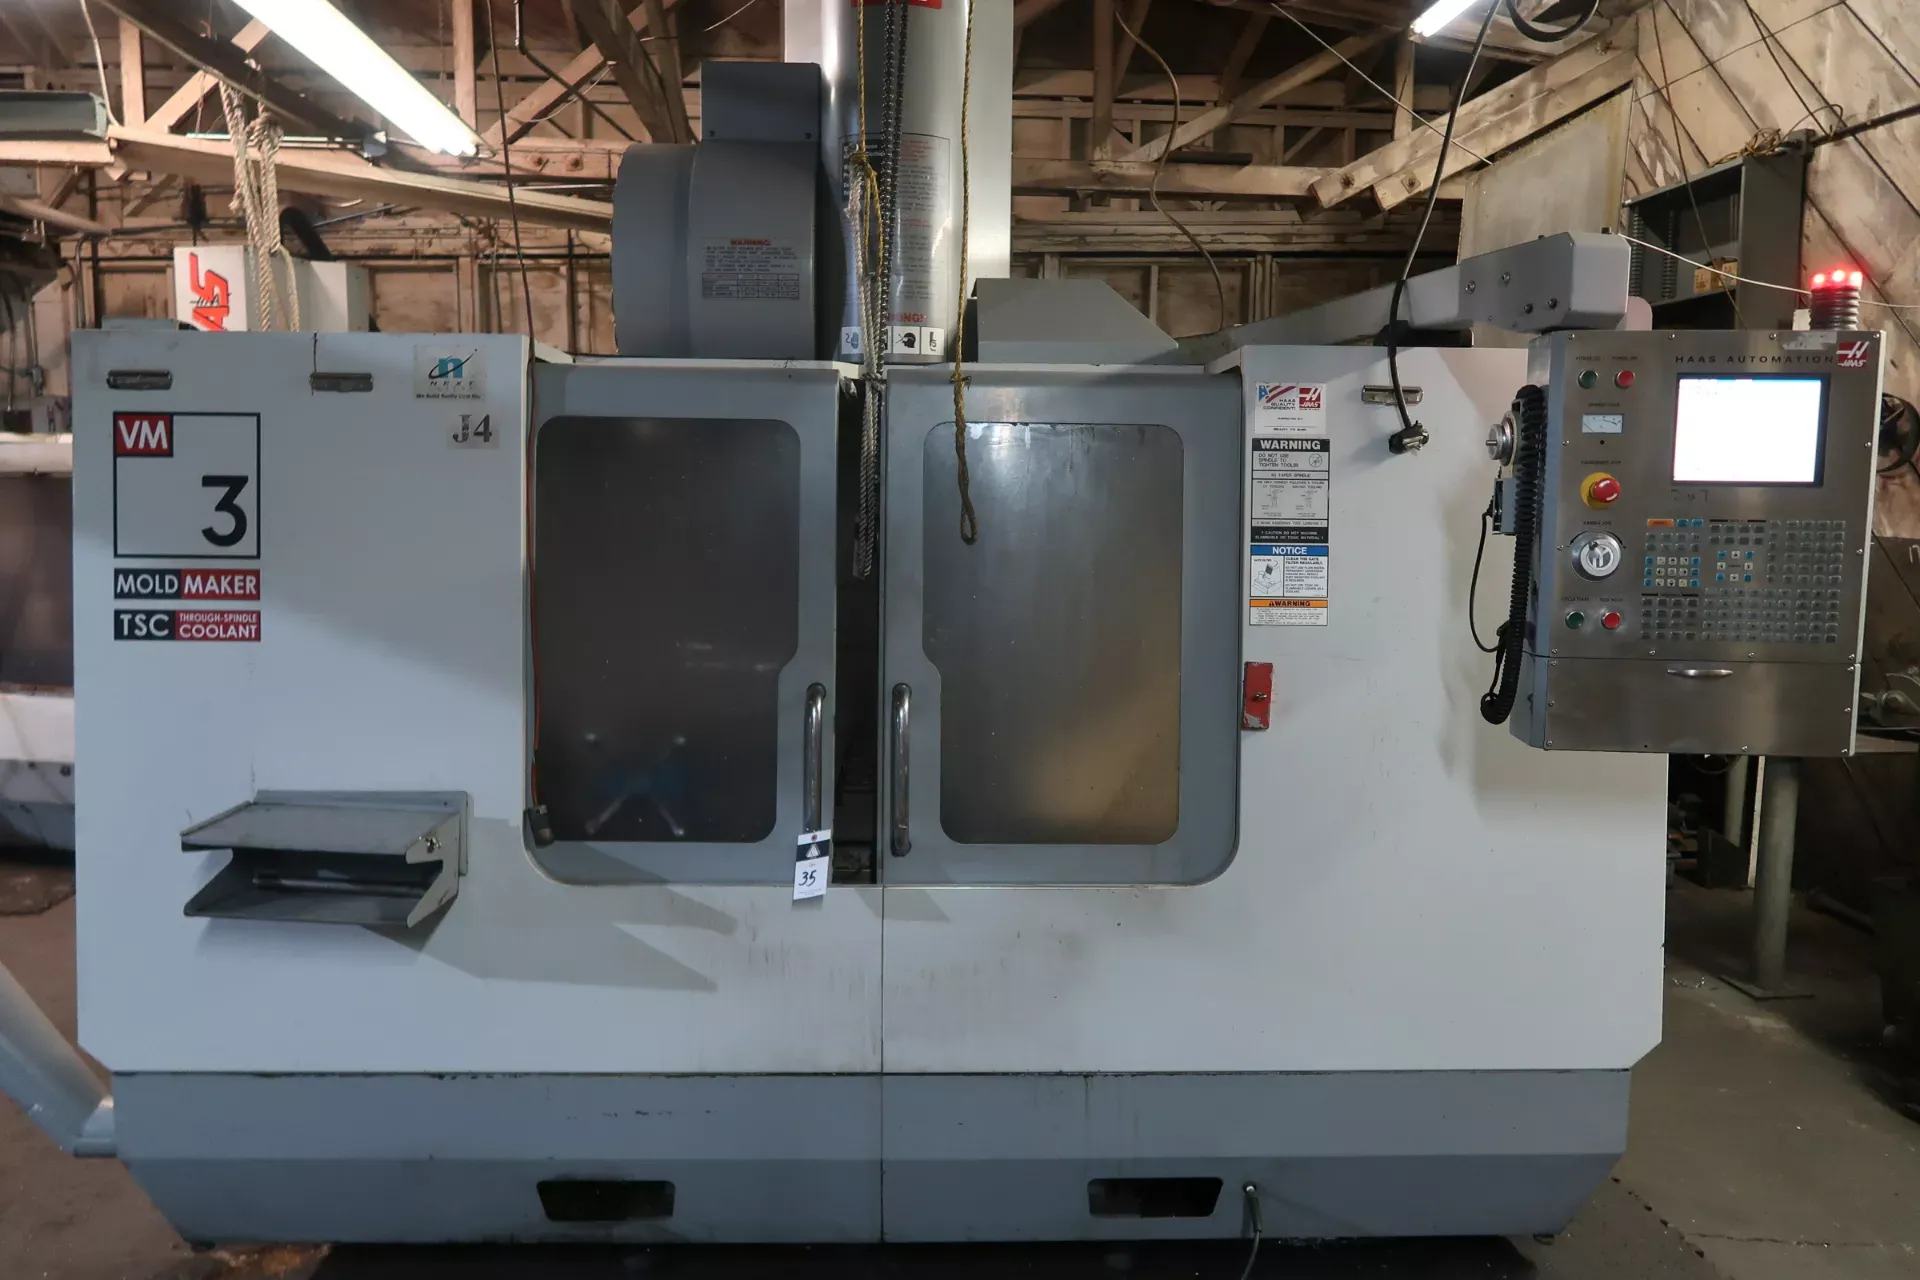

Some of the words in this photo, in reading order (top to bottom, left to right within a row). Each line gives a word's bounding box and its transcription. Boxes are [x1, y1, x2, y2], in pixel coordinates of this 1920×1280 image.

[1675, 355, 1717, 364] HAAS
[1726, 355, 1834, 364] AUTOMATION
[117, 420, 168, 449] VM
[452, 414, 492, 443] J4
[1260, 440, 1320, 450] WARNING
[202, 475, 248, 547] 3
[116, 574, 178, 594] MOLD
[184, 574, 257, 595] MAKER
[120, 614, 170, 636] TSC
[179, 612, 257, 623] THROUGH-SPINDLE
[179, 624, 257, 638] COOLANT
[798, 870, 817, 886] 35
